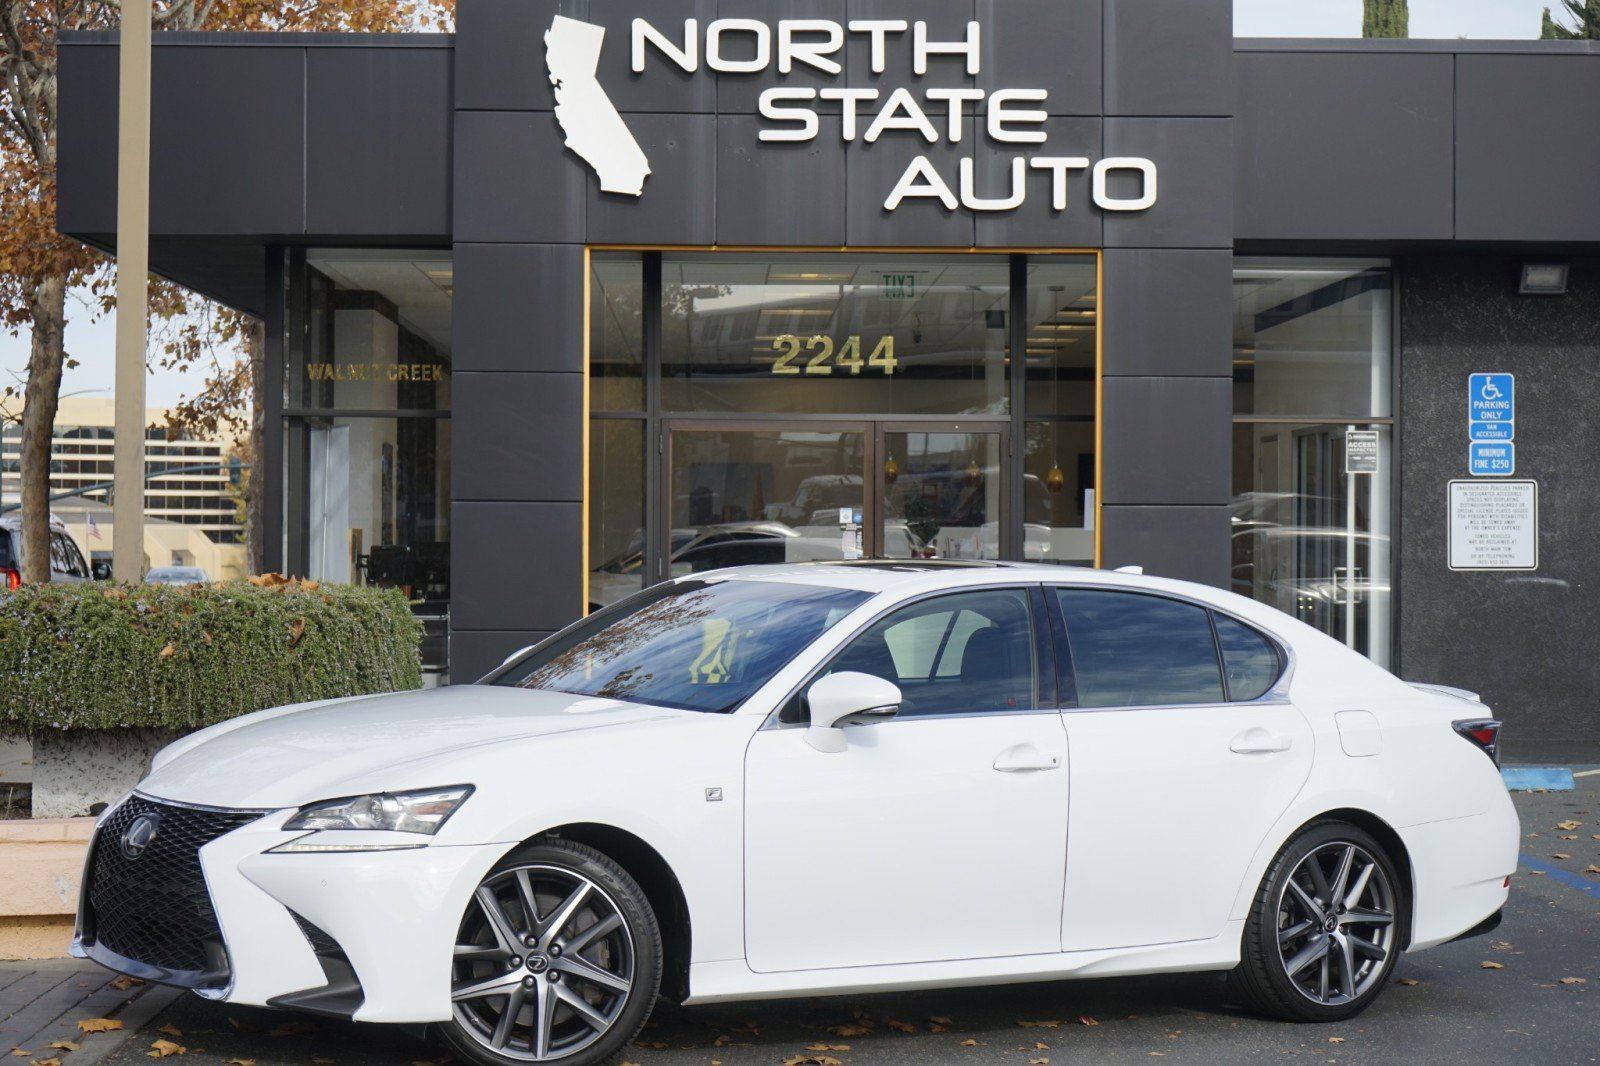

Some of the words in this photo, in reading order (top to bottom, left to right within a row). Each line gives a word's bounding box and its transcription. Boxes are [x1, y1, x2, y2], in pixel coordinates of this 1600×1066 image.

[632, 18, 981, 75] NORTH
[759, 88, 1048, 143] STATE
[884, 156, 1157, 211] AUTO
[772, 334, 898, 375] 2244
[307, 363, 383, 381] WALNUT
[386, 363, 443, 381] CREEK
[1473, 401, 1510, 409] PARKING
[1480, 411, 1503, 420] ONLY
[1478, 448, 1506, 457] MINIMUM
[1474, 460, 1489, 469] FINE
[1491, 460, 1510, 470] $250
